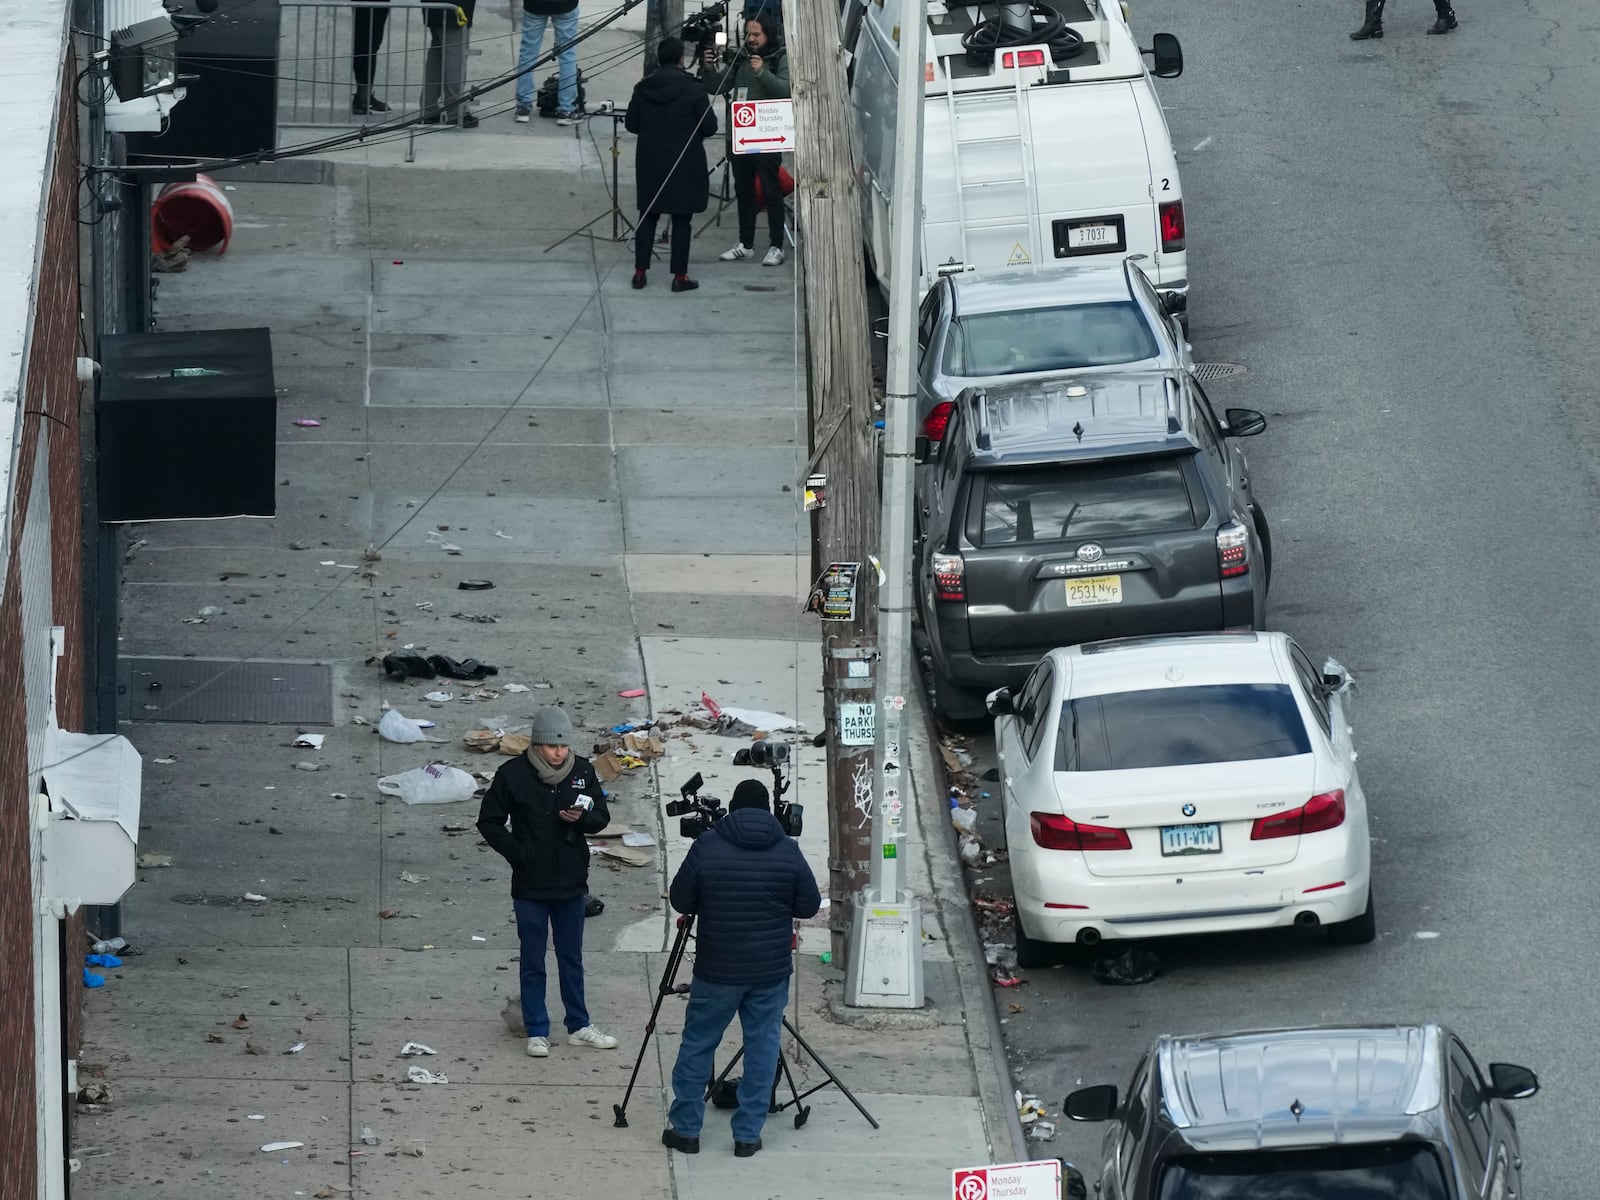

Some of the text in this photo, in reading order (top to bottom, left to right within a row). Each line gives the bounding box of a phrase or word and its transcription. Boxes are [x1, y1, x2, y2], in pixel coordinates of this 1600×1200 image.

[758, 107, 779, 115] Monday
[1161, 178, 1170, 191] 2
[1086, 227, 1106, 241] 7037
[1055, 561, 1128, 574] 4RUNNER
[1070, 585, 1097, 599] 2531
[859, 705, 872, 716] NO
[845, 717, 875, 728] PARKI
[991, 1176, 1021, 1186] Monday
[992, 1187, 1027, 1198] Thursday
